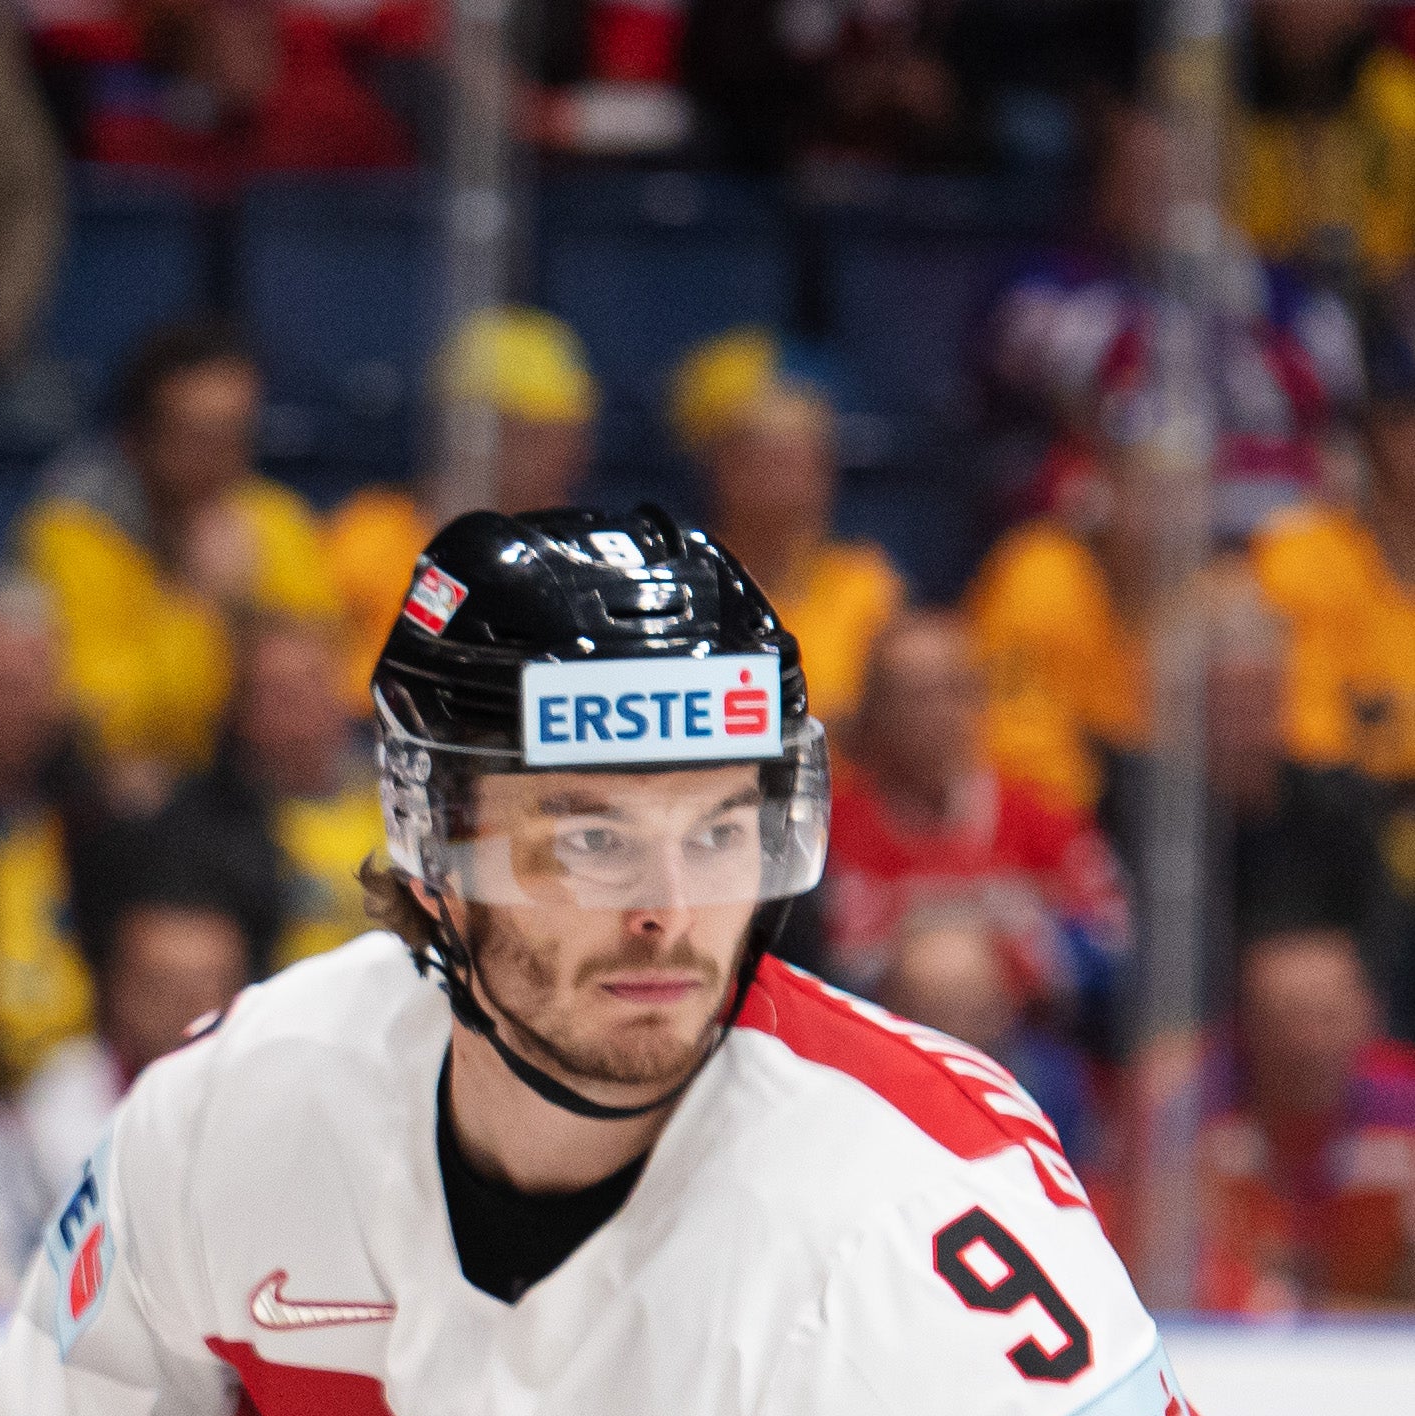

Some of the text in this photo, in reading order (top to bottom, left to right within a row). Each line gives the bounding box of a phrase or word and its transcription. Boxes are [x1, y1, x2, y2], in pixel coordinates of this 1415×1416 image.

[588, 531, 646, 568] 9
[538, 690, 713, 744] ERSTE
[933, 1205, 1093, 1384] 9
